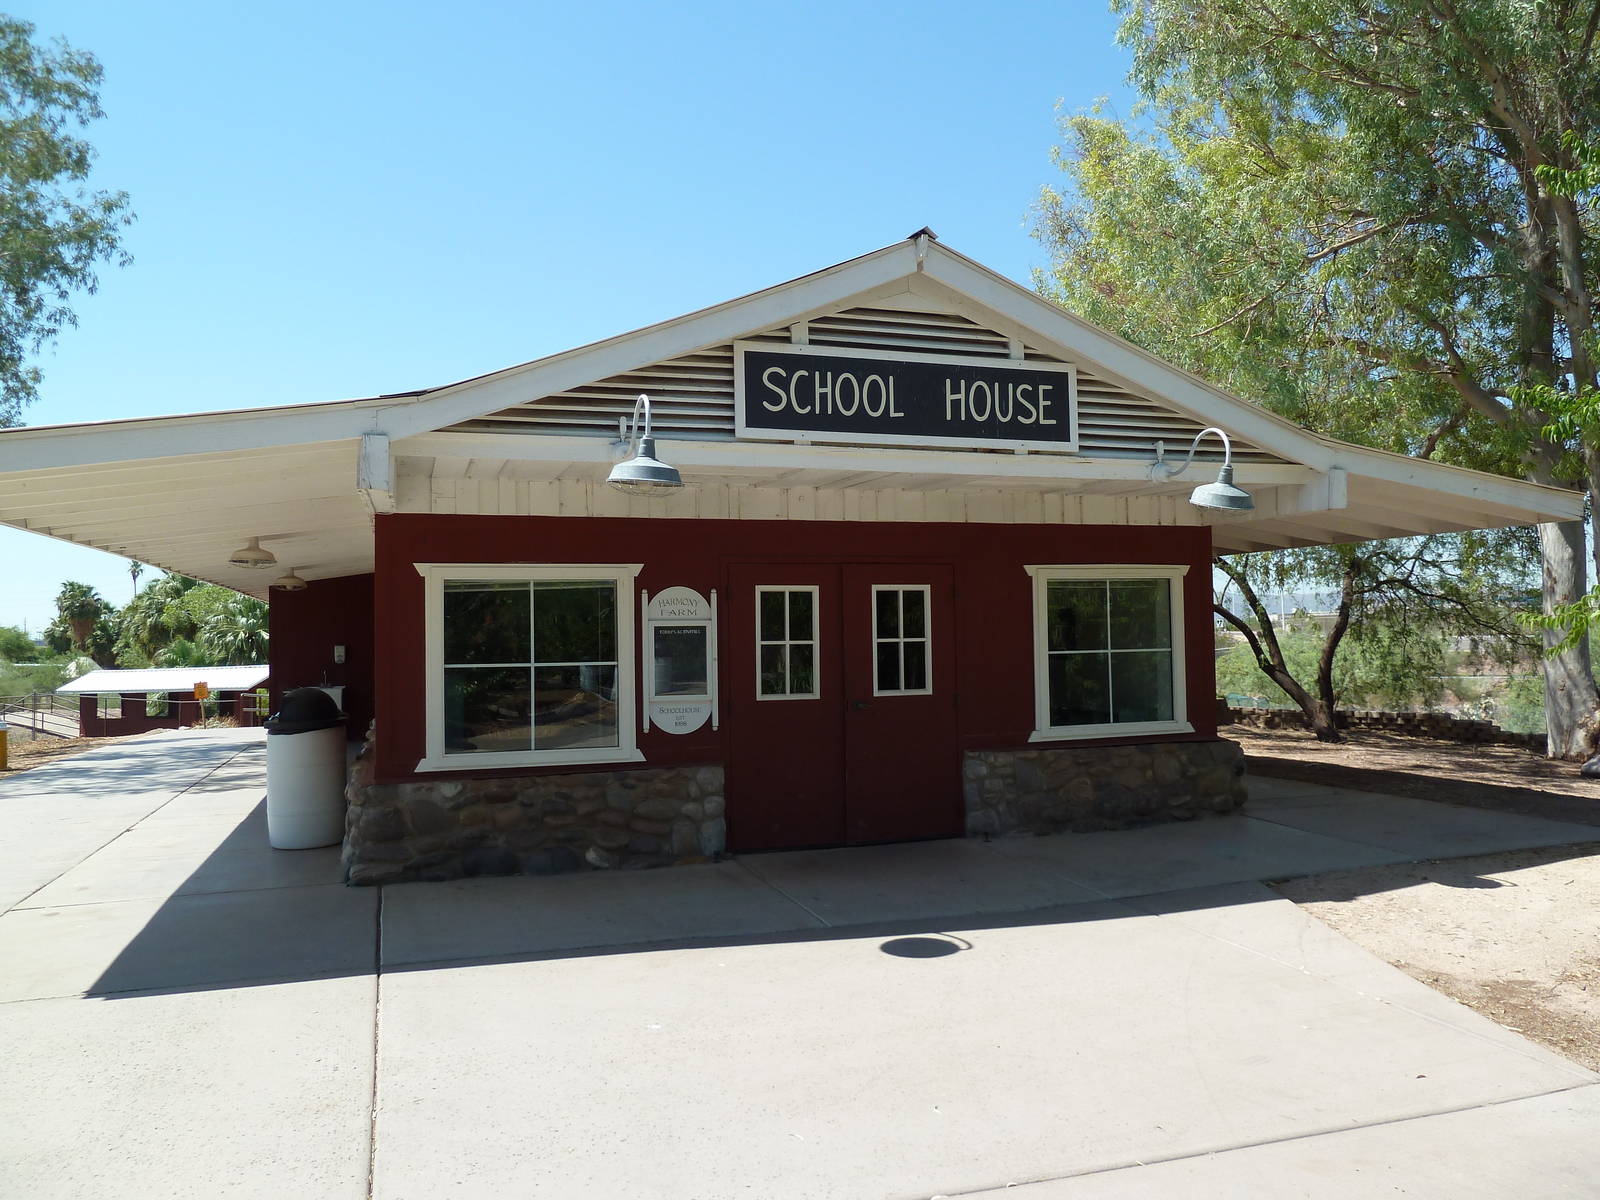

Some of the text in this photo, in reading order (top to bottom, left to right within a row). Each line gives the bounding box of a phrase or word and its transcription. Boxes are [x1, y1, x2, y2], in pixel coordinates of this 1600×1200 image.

[762, 366, 1057, 425] SCHOOL HOUSE
[658, 597, 698, 608] HARMONY
